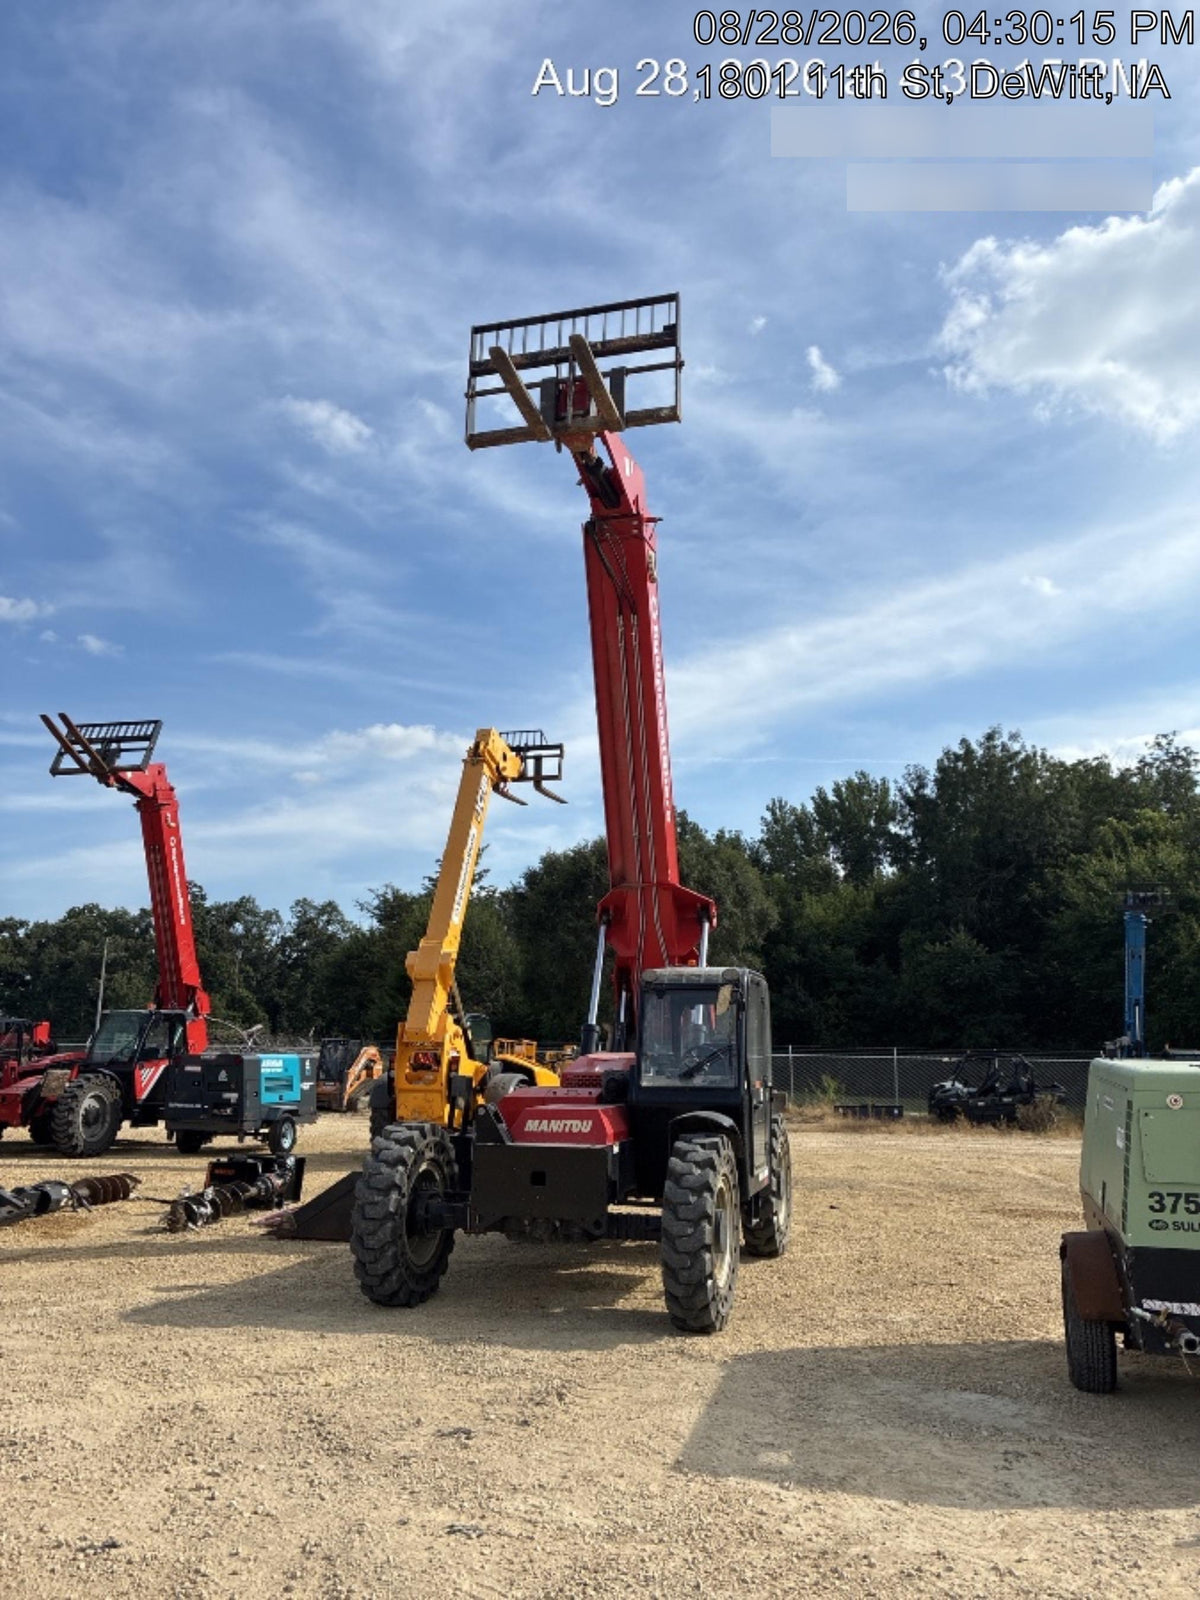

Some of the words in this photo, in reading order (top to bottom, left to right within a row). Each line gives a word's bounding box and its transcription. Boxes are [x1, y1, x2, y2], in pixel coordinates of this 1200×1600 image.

[524, 1119, 594, 1134] MANITOU
[1148, 1191, 1200, 1214] 375
[1172, 1221, 1200, 1232] SUL
